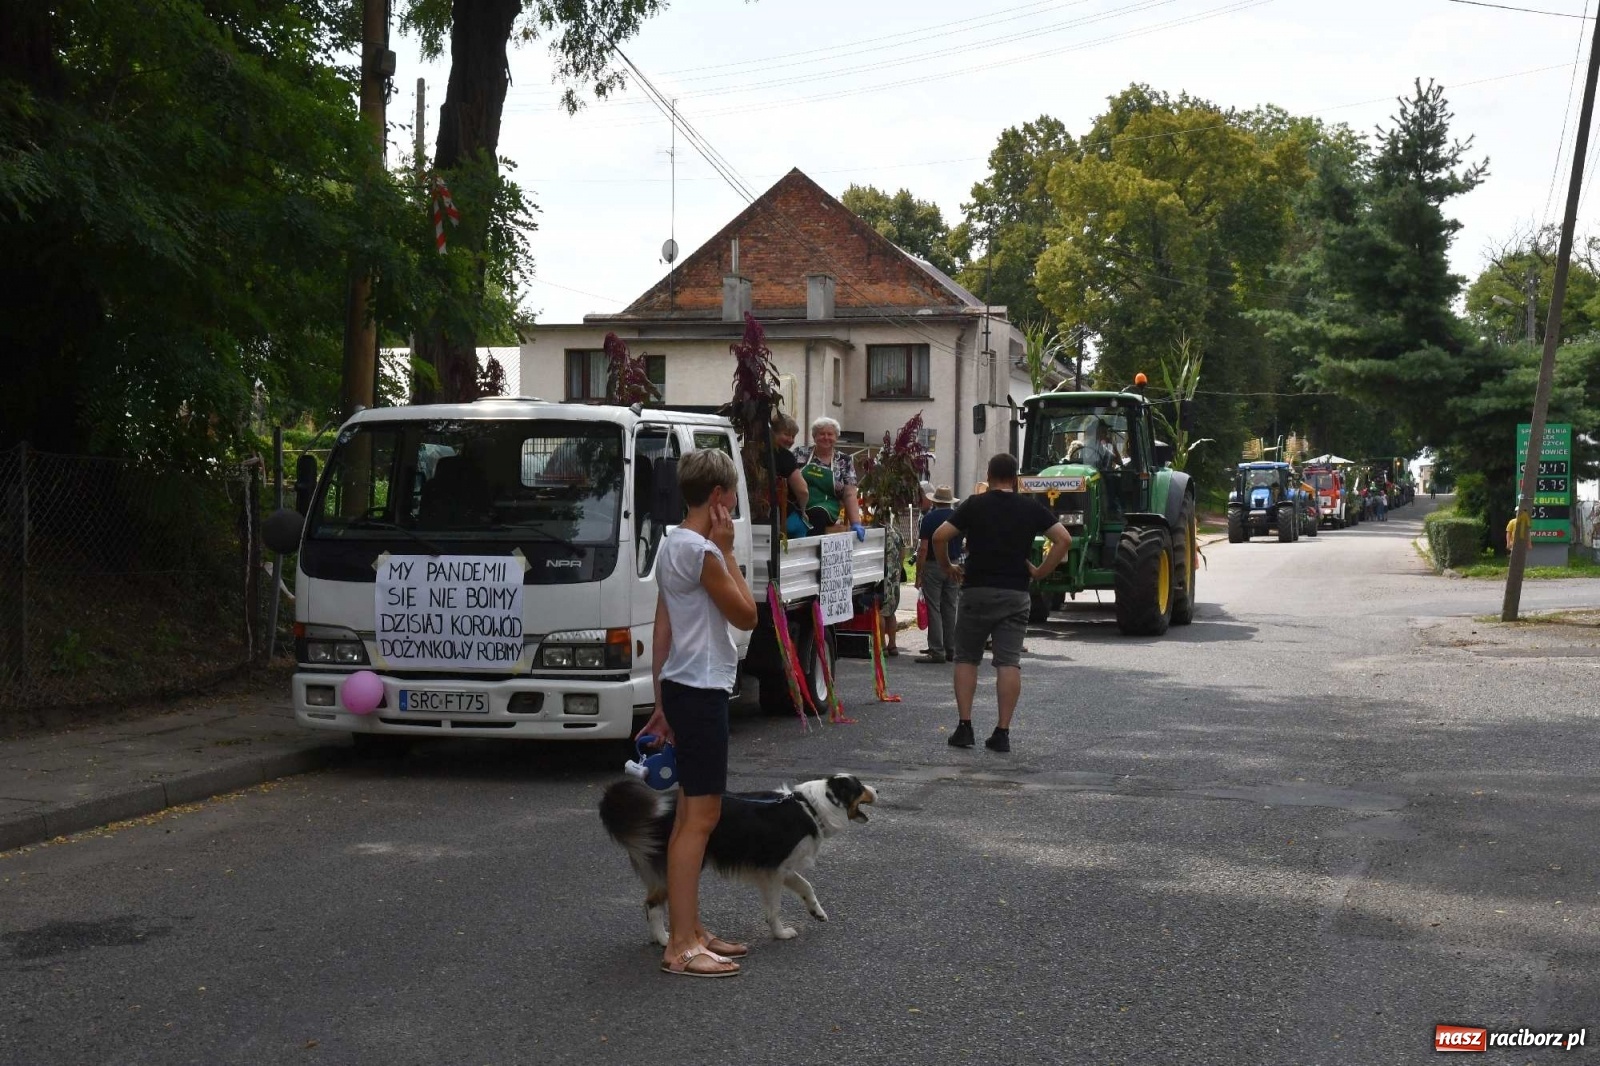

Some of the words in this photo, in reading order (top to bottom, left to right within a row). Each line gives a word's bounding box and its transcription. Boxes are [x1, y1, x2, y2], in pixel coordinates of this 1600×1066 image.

[1023, 480, 1081, 488] KRZANOWICE
[388, 561, 414, 581] MY
[426, 561, 506, 582] PANDEMII
[545, 559, 582, 568] NPR
[387, 587, 417, 610] SIĘ
[429, 588, 457, 608] NIE
[466, 586, 517, 610] BOIMY
[380, 613, 443, 635] DZISIAJ
[451, 614, 522, 638] KOROWÓD
[380, 636, 473, 660] DOŻYNKOWY
[477, 641, 523, 661] ROBIMY
